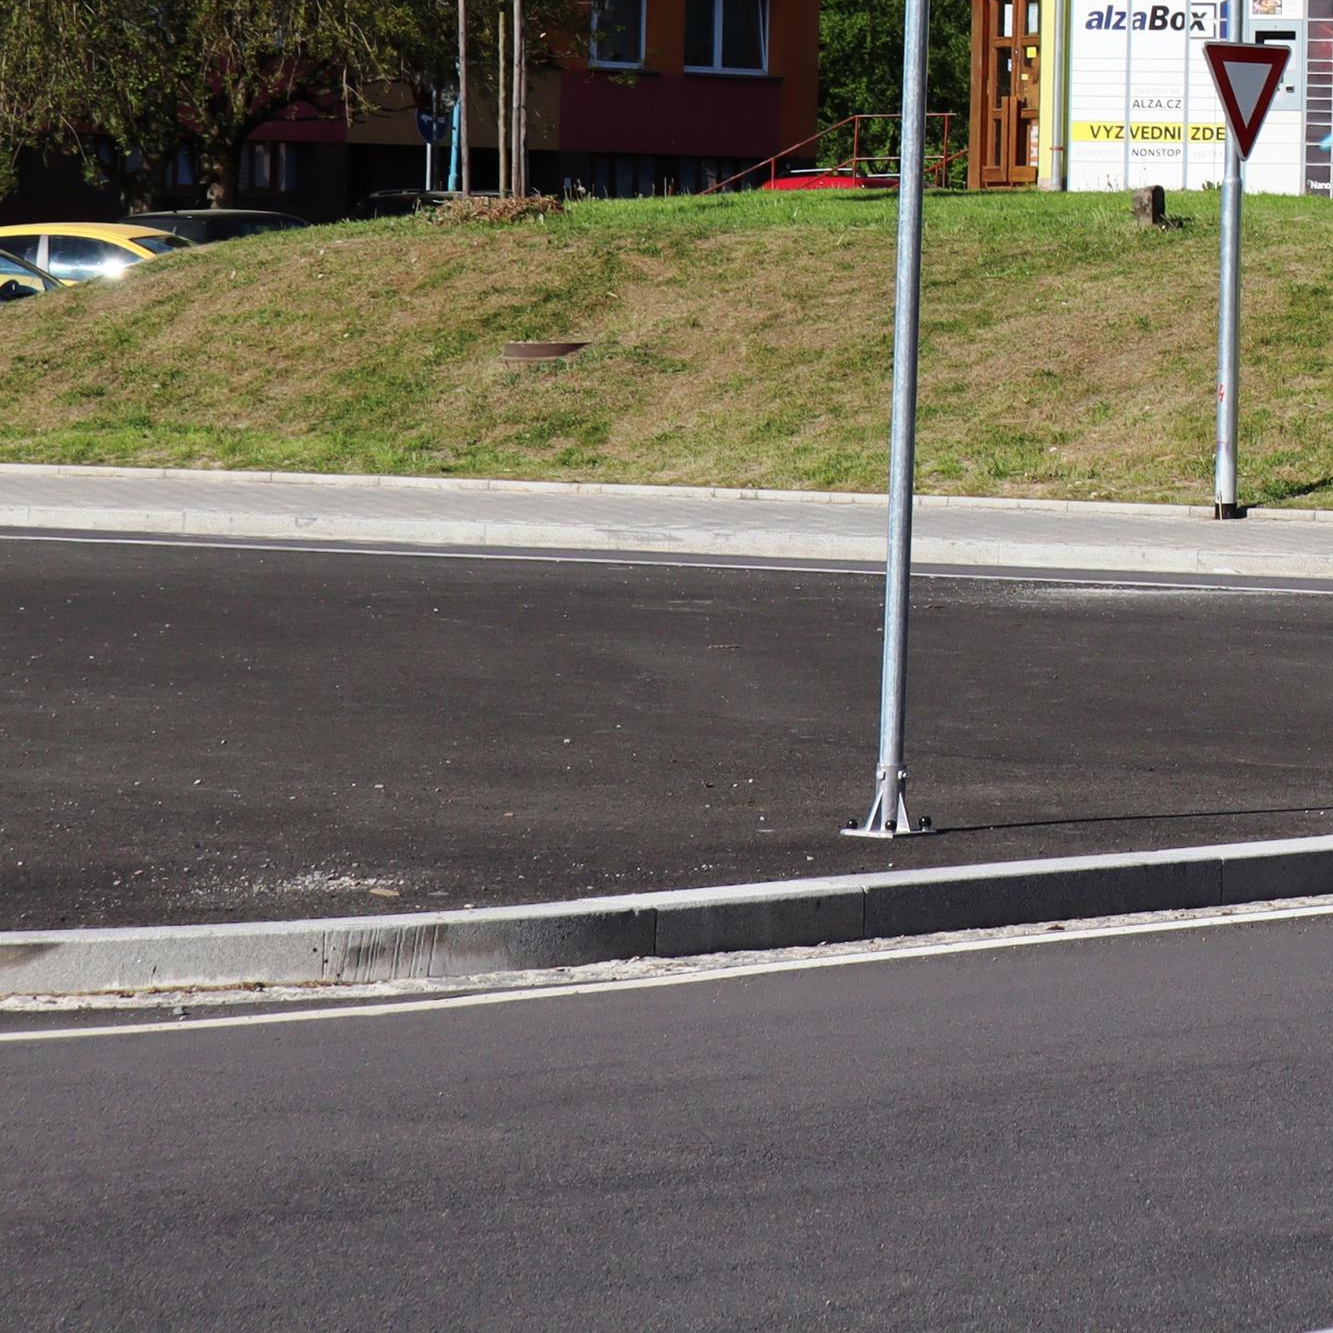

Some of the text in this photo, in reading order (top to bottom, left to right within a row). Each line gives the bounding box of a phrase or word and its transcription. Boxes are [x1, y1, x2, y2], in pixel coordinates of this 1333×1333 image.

[1085, 4, 1207, 31] alzaBox
[1132, 99, 1182, 109] ALZA.CZ
[1089, 124, 1225, 142] VYZVEDNI ZDE
[1131, 148, 1181, 157] NONSTOP
